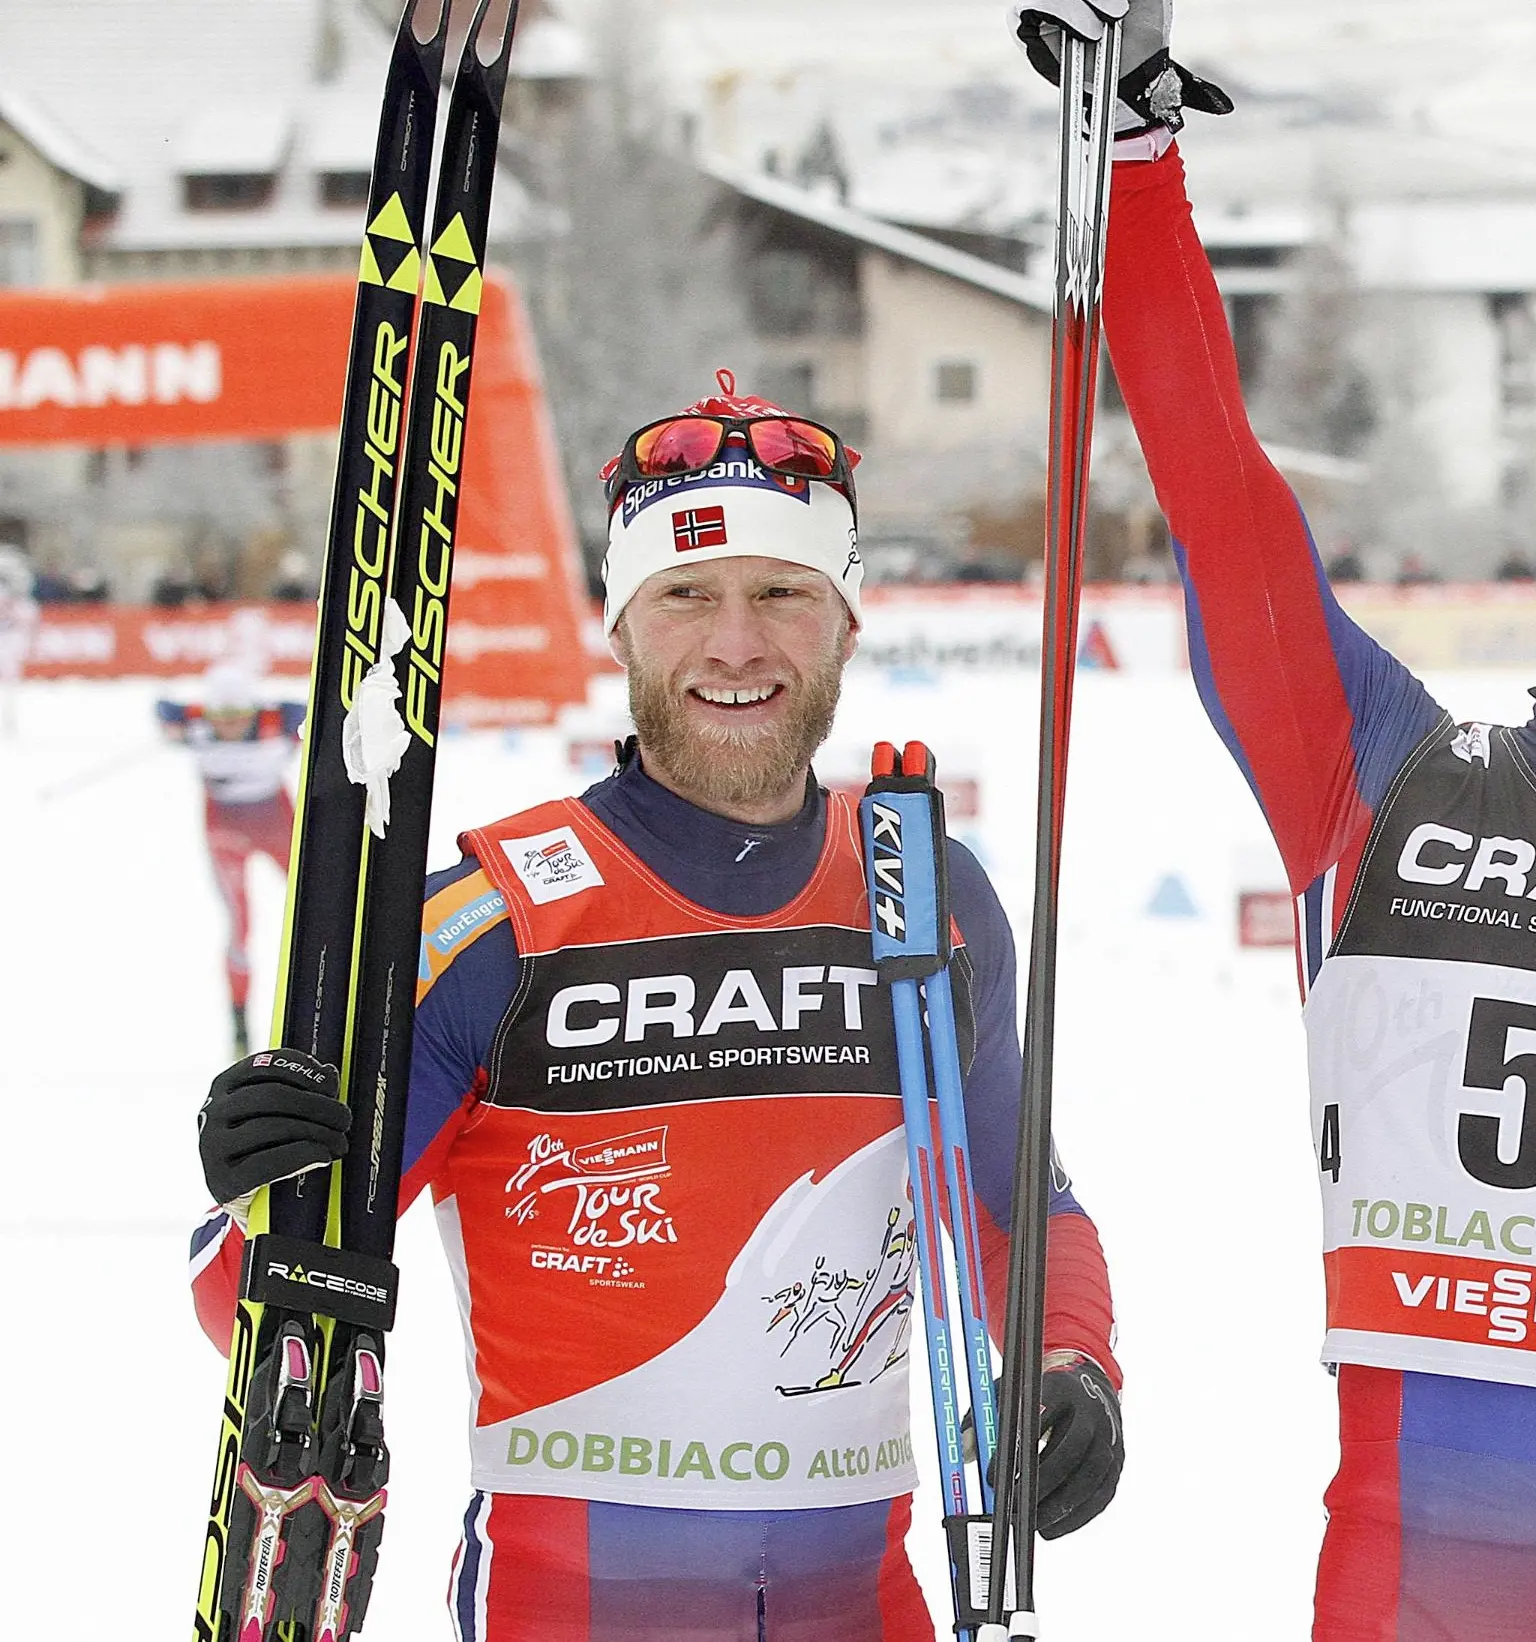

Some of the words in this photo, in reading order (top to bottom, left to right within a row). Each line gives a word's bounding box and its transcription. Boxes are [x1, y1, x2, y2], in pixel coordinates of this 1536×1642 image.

[0, 341, 222, 411] ANN
[340, 320, 408, 711] FISCHER
[406, 340, 471, 748] FISCHER
[872, 802, 906, 941] KV+
[1390, 898, 1522, 930] FUNCTIONAL
[546, 965, 878, 1048] CRAFT
[273, 1058, 326, 1084] DÆHLIE
[548, 1053, 702, 1084] FUNCTIONAL
[708, 1046, 870, 1068] SPORTSWEAR
[527, 1134, 564, 1164] 10th
[579, 1141, 658, 1166] VIESSMANN
[1321, 1103, 1341, 1183] 4
[567, 1183, 666, 1234] TOUR
[573, 1220, 608, 1247] de
[608, 1209, 678, 1248] Ski
[531, 1250, 612, 1274] CRAFT
[589, 1278, 645, 1289] SPORTSWEAR
[937, 1328, 959, 1465] TORNADO
[974, 1329, 997, 1459] TORNAD
[507, 1427, 790, 1481] DOBBIACO
[807, 1447, 870, 1479] ALtO
